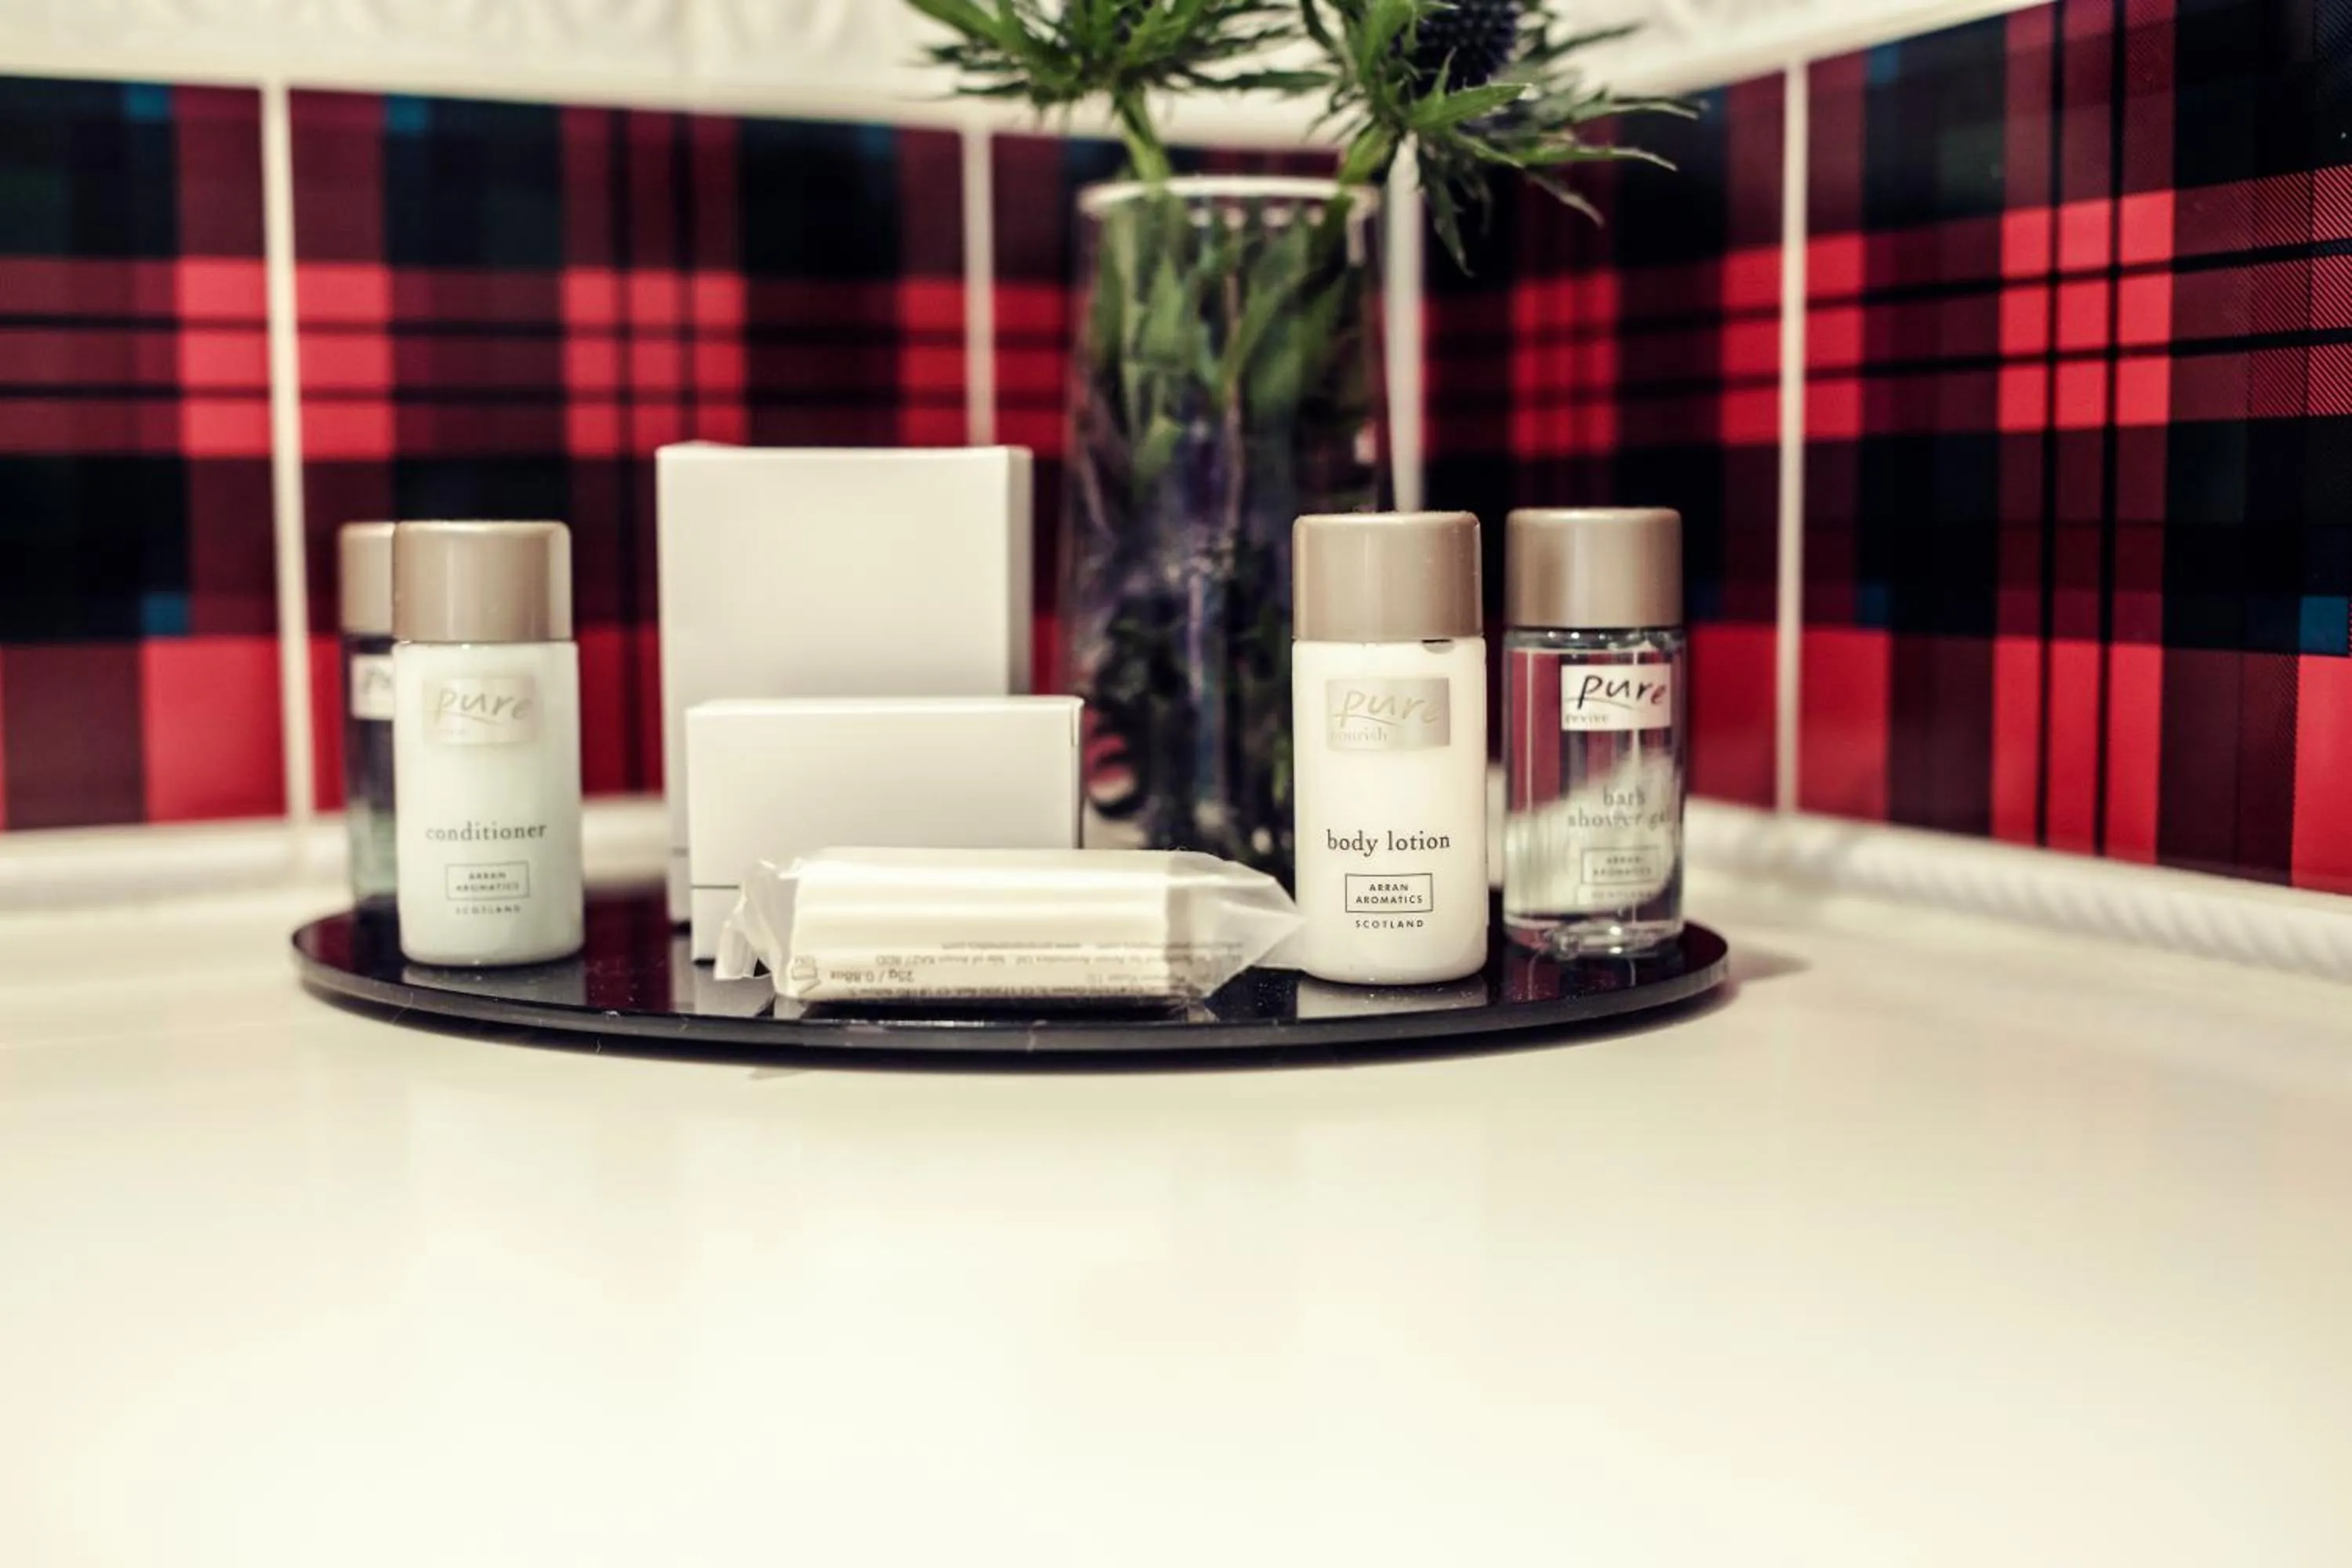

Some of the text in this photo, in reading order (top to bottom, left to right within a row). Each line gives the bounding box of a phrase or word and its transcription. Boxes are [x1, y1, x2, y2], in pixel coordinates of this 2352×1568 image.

[434, 687, 534, 725] pure
[1577, 674, 1667, 710] pure
[1340, 690, 1441, 728] pure
[426, 820, 548, 841] conditioner
[1327, 829, 1450, 857] body lotion
[1356, 895, 1423, 904] AROMATICS
[1356, 920, 1425, 929] SCOTLAND
